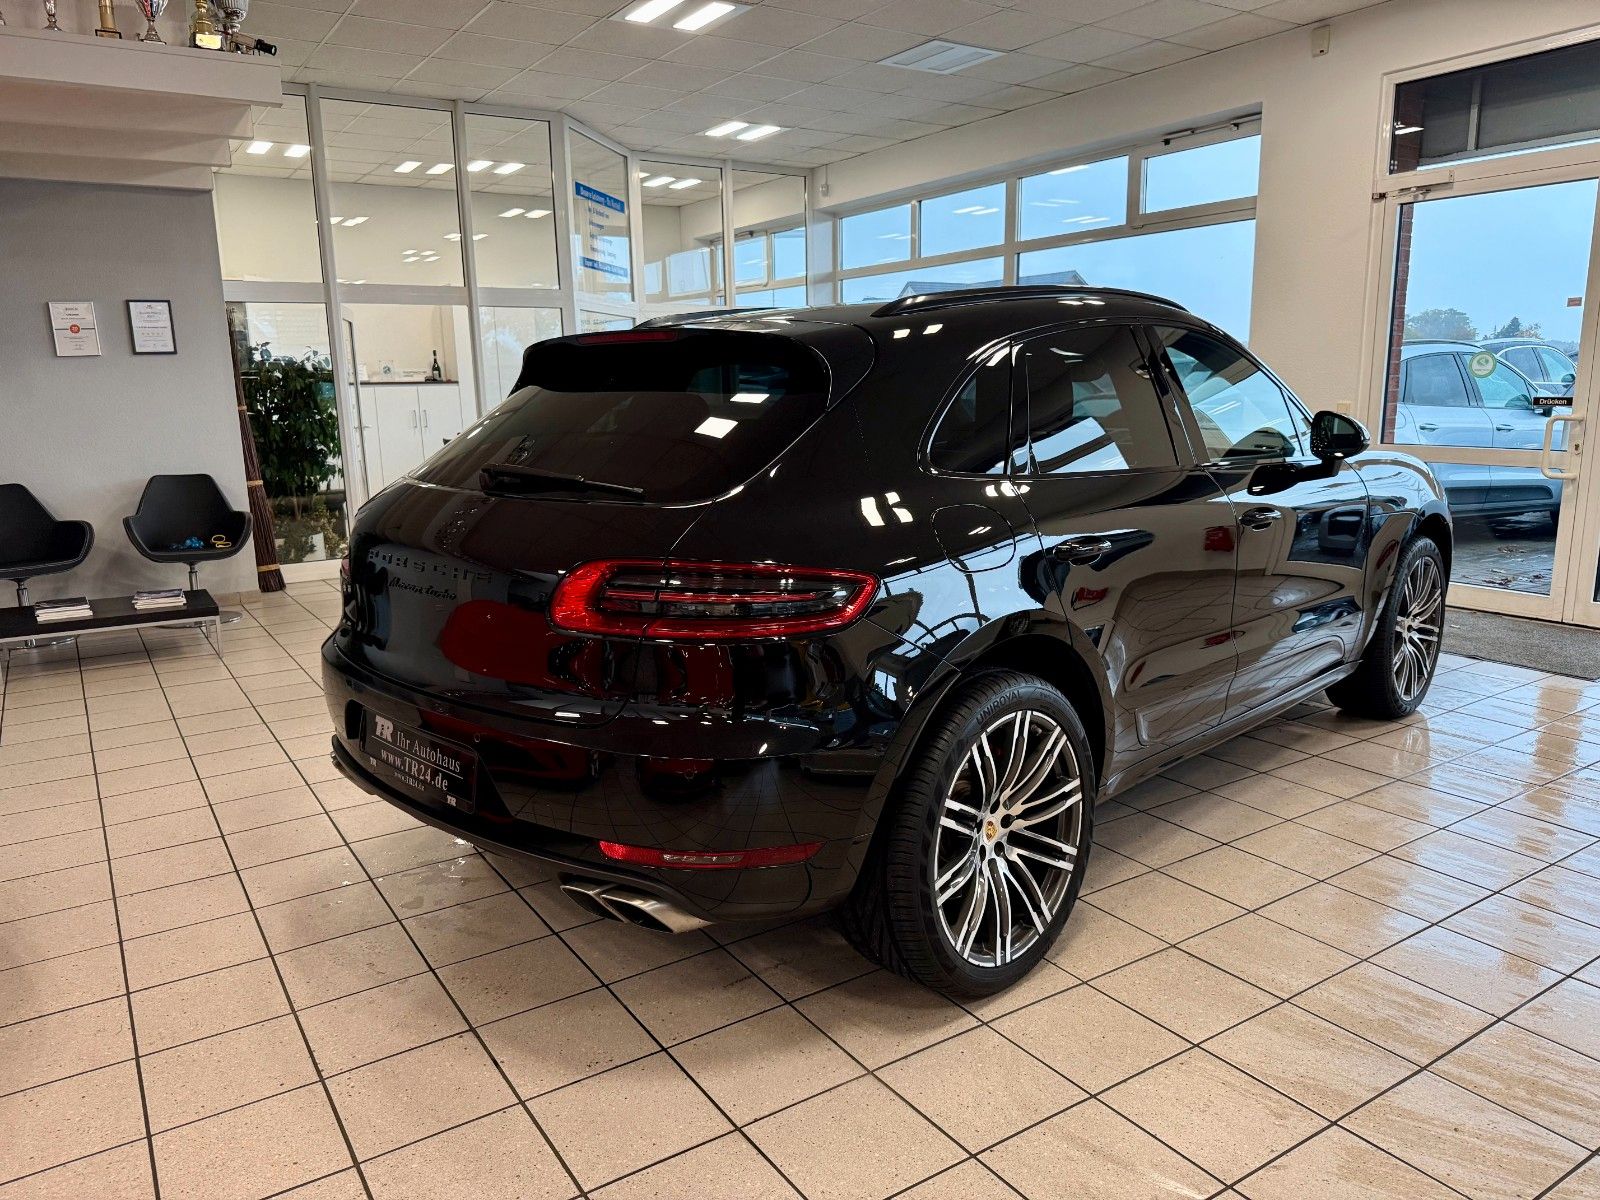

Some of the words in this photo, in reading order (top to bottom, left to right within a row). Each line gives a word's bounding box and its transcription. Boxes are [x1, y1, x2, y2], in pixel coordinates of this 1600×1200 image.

[976, 690, 1022, 725] UNIROYAL
[381, 749, 448, 791] www.TR24.de
[397, 731, 410, 750] Ihr
[413, 740, 460, 773] Autohaus
